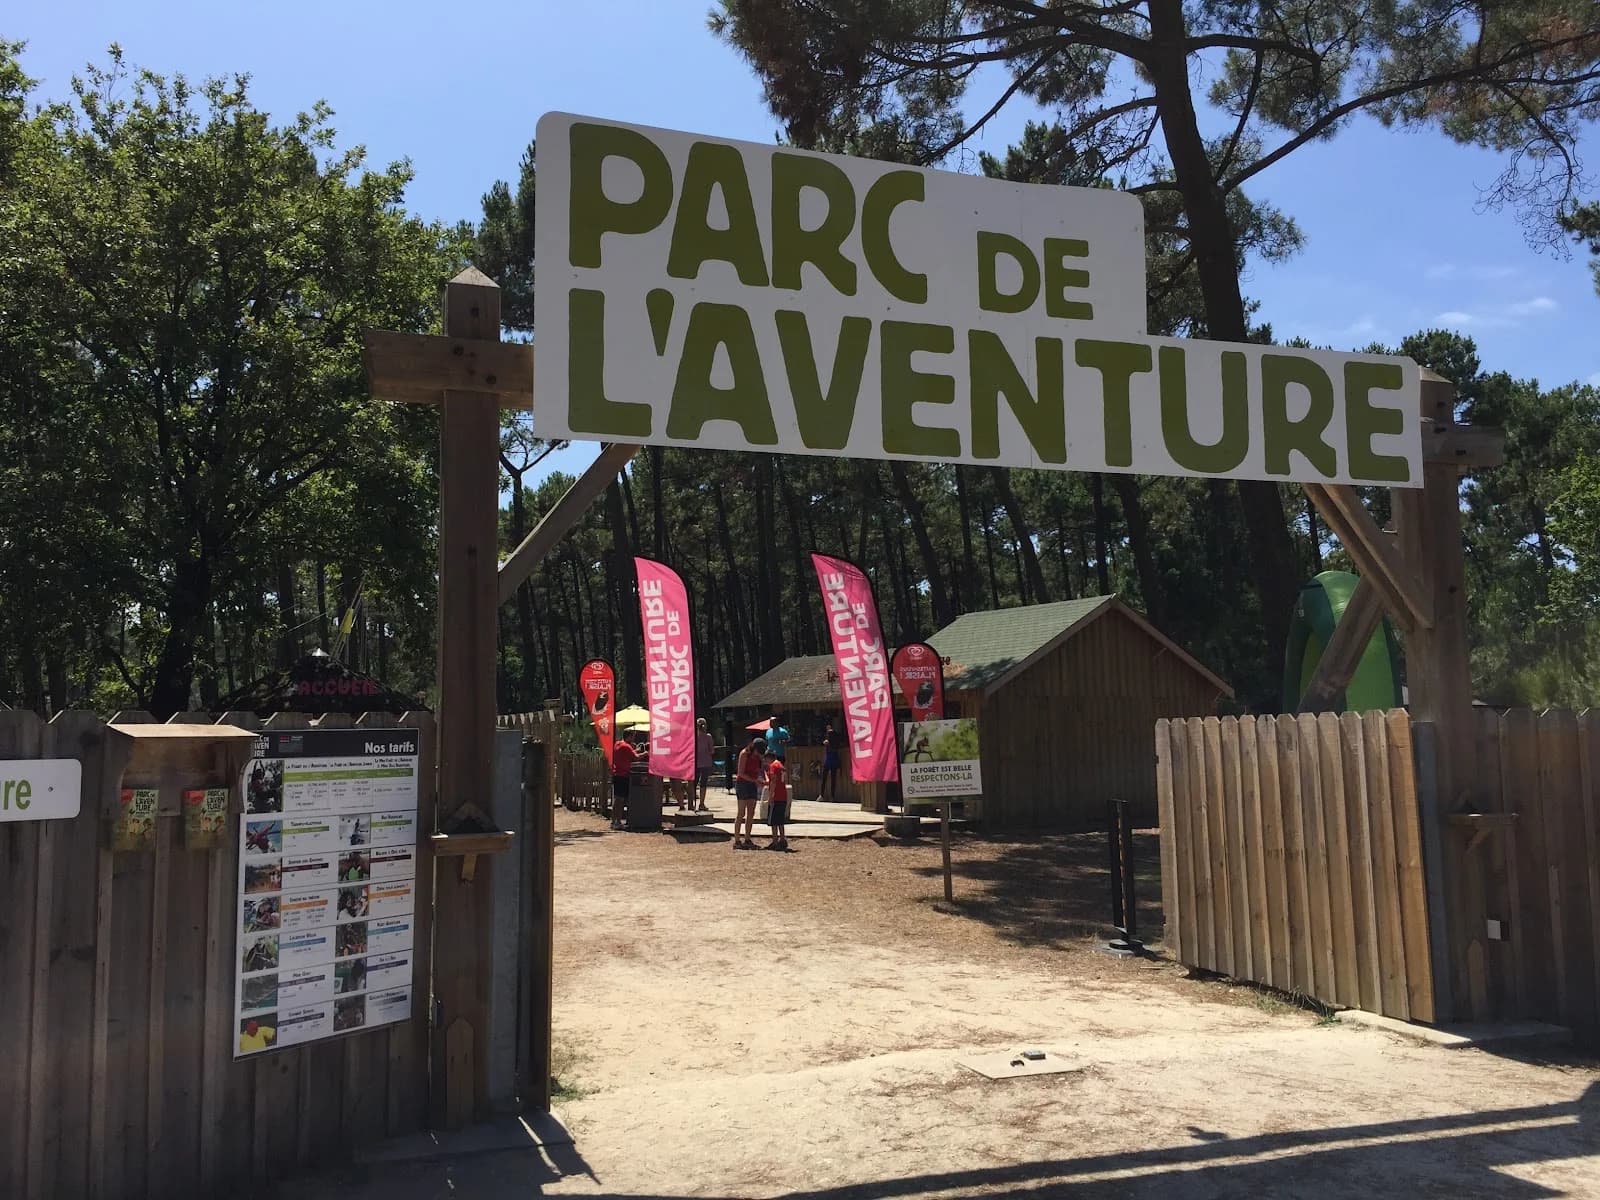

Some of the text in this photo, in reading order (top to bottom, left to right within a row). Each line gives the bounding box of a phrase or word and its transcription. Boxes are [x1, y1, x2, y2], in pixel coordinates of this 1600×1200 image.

[569, 121, 1094, 321] PARC DE
[567, 287, 1411, 483] L'AVENTURE
[364, 740, 415, 754] Nos tarifs
[940, 765, 952, 773] EST
[953, 764, 972, 772] BELLE
[0, 779, 32, 811] re
